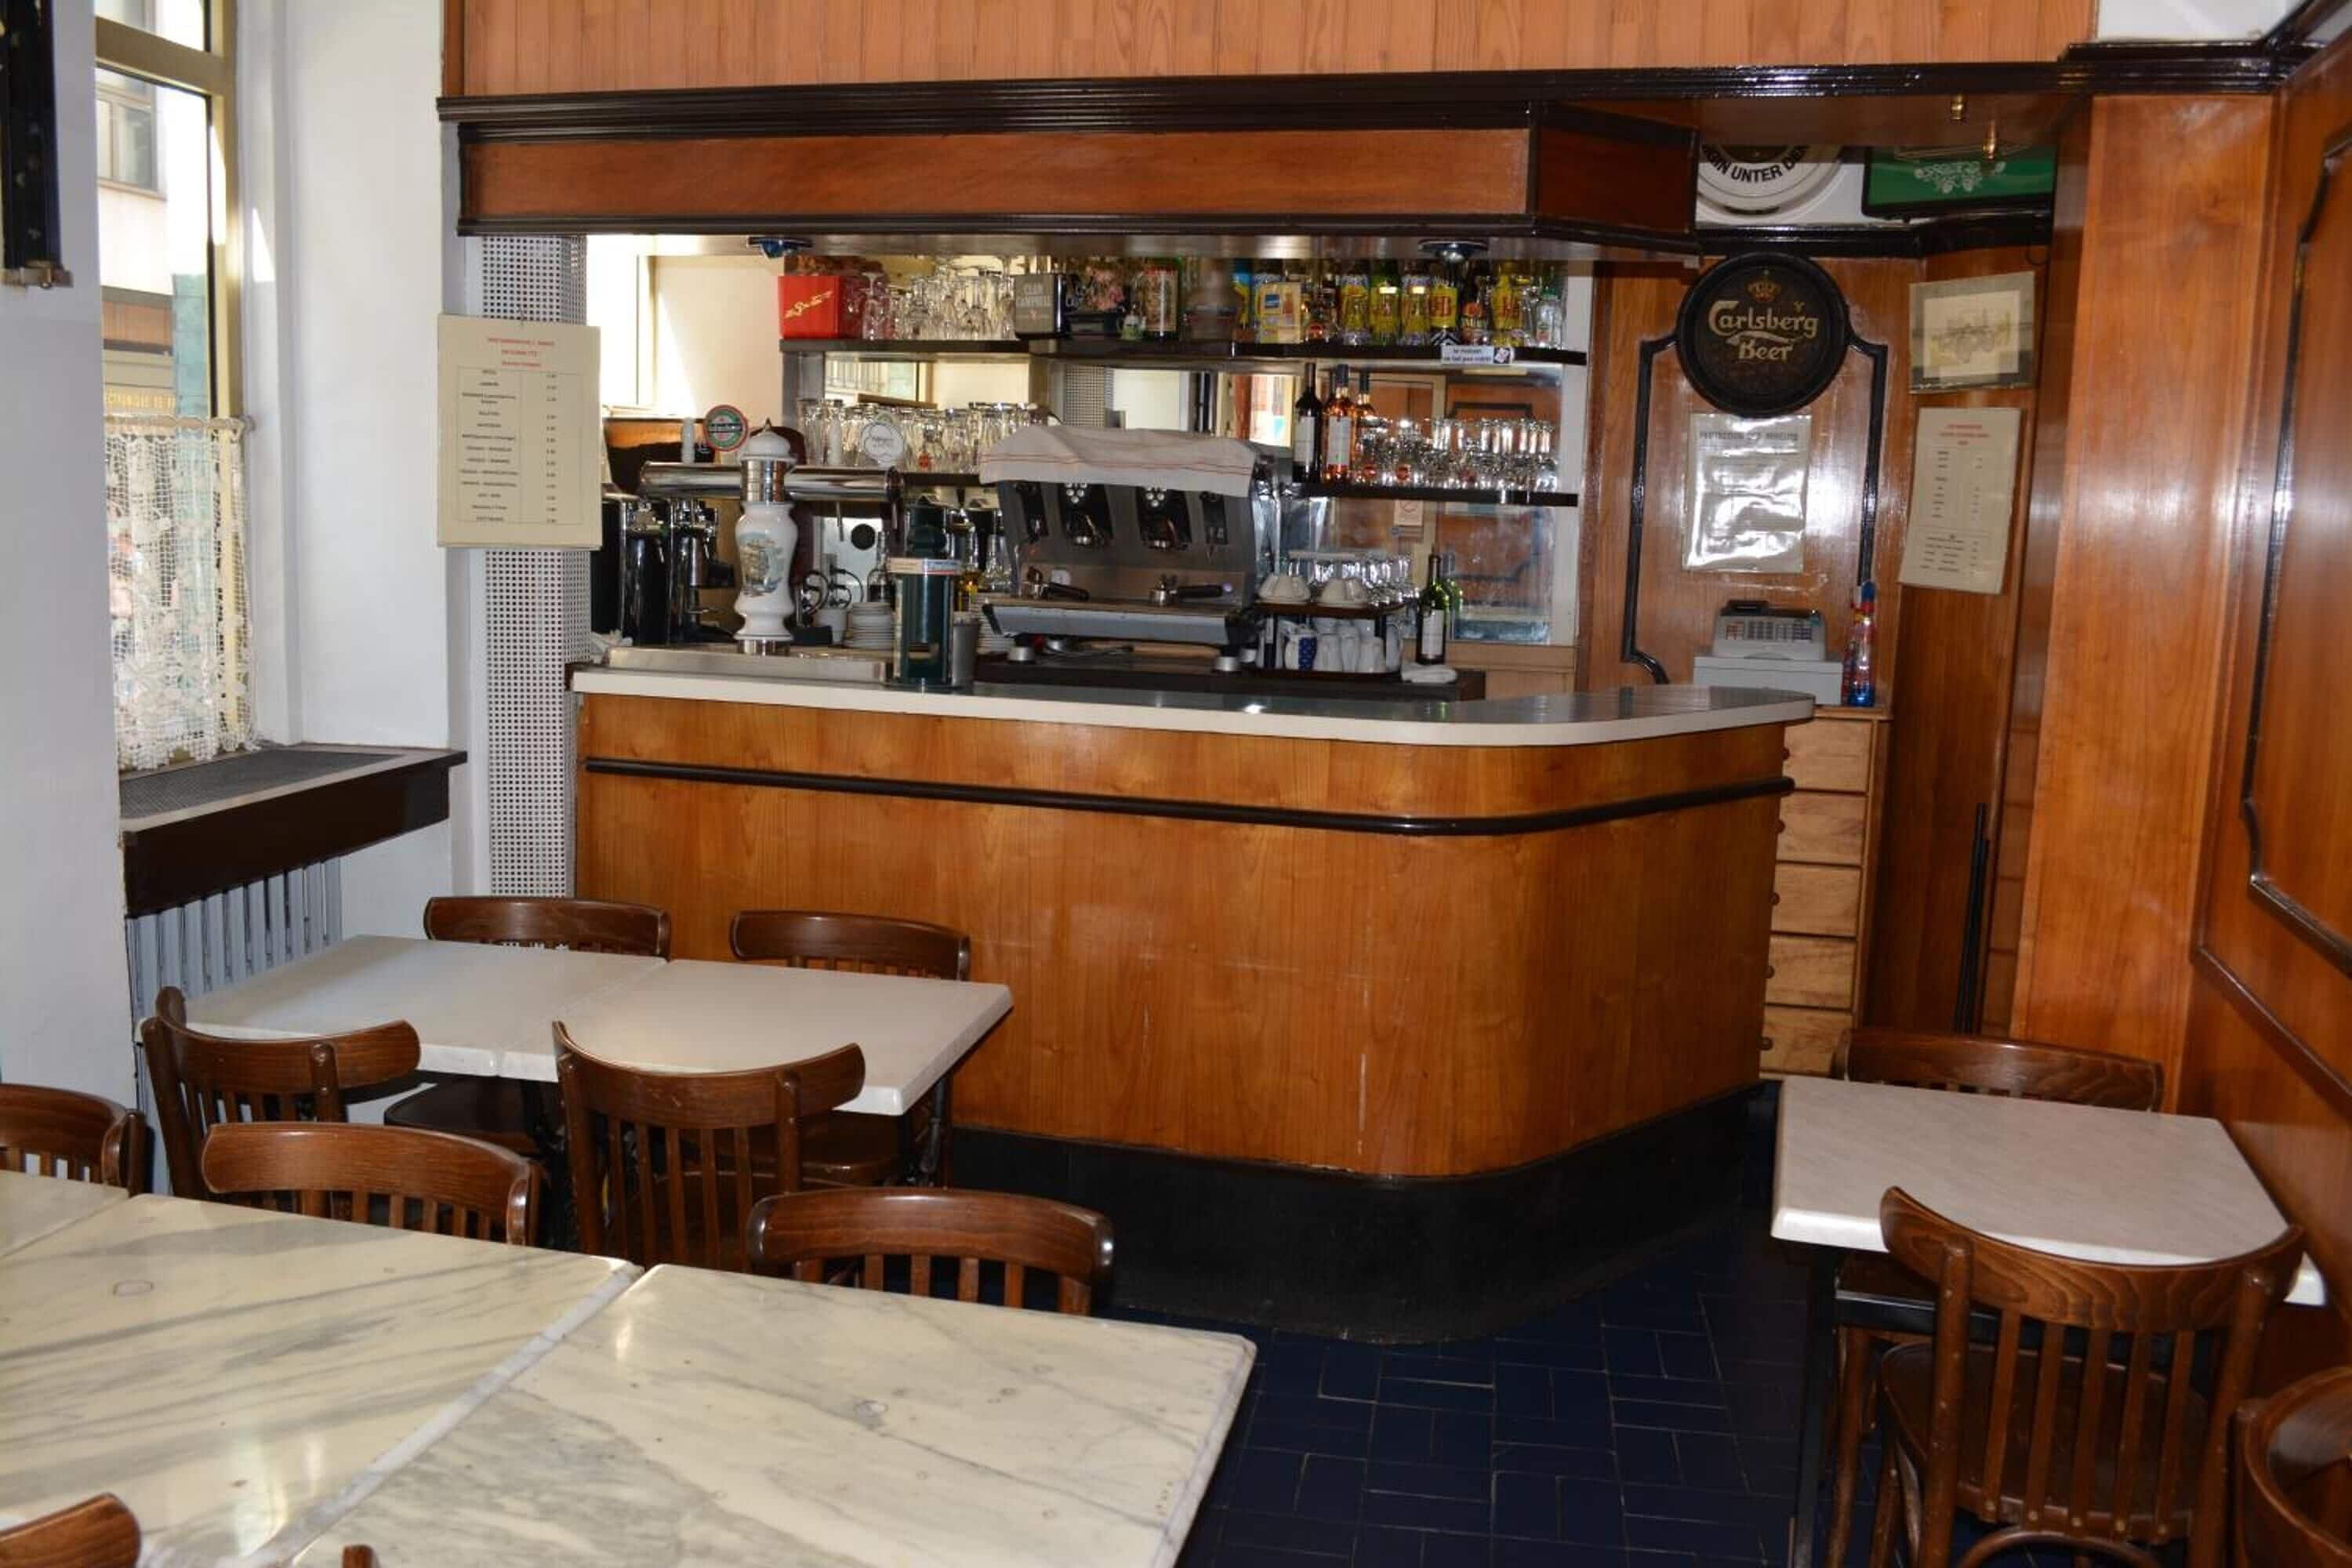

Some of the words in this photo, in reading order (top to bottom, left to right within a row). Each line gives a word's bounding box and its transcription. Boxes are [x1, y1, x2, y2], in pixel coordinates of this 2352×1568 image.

[1730, 165, 1783, 183] UNTER
[1708, 300, 1820, 339] Carlsberg
[1738, 339, 1794, 364] Beer
